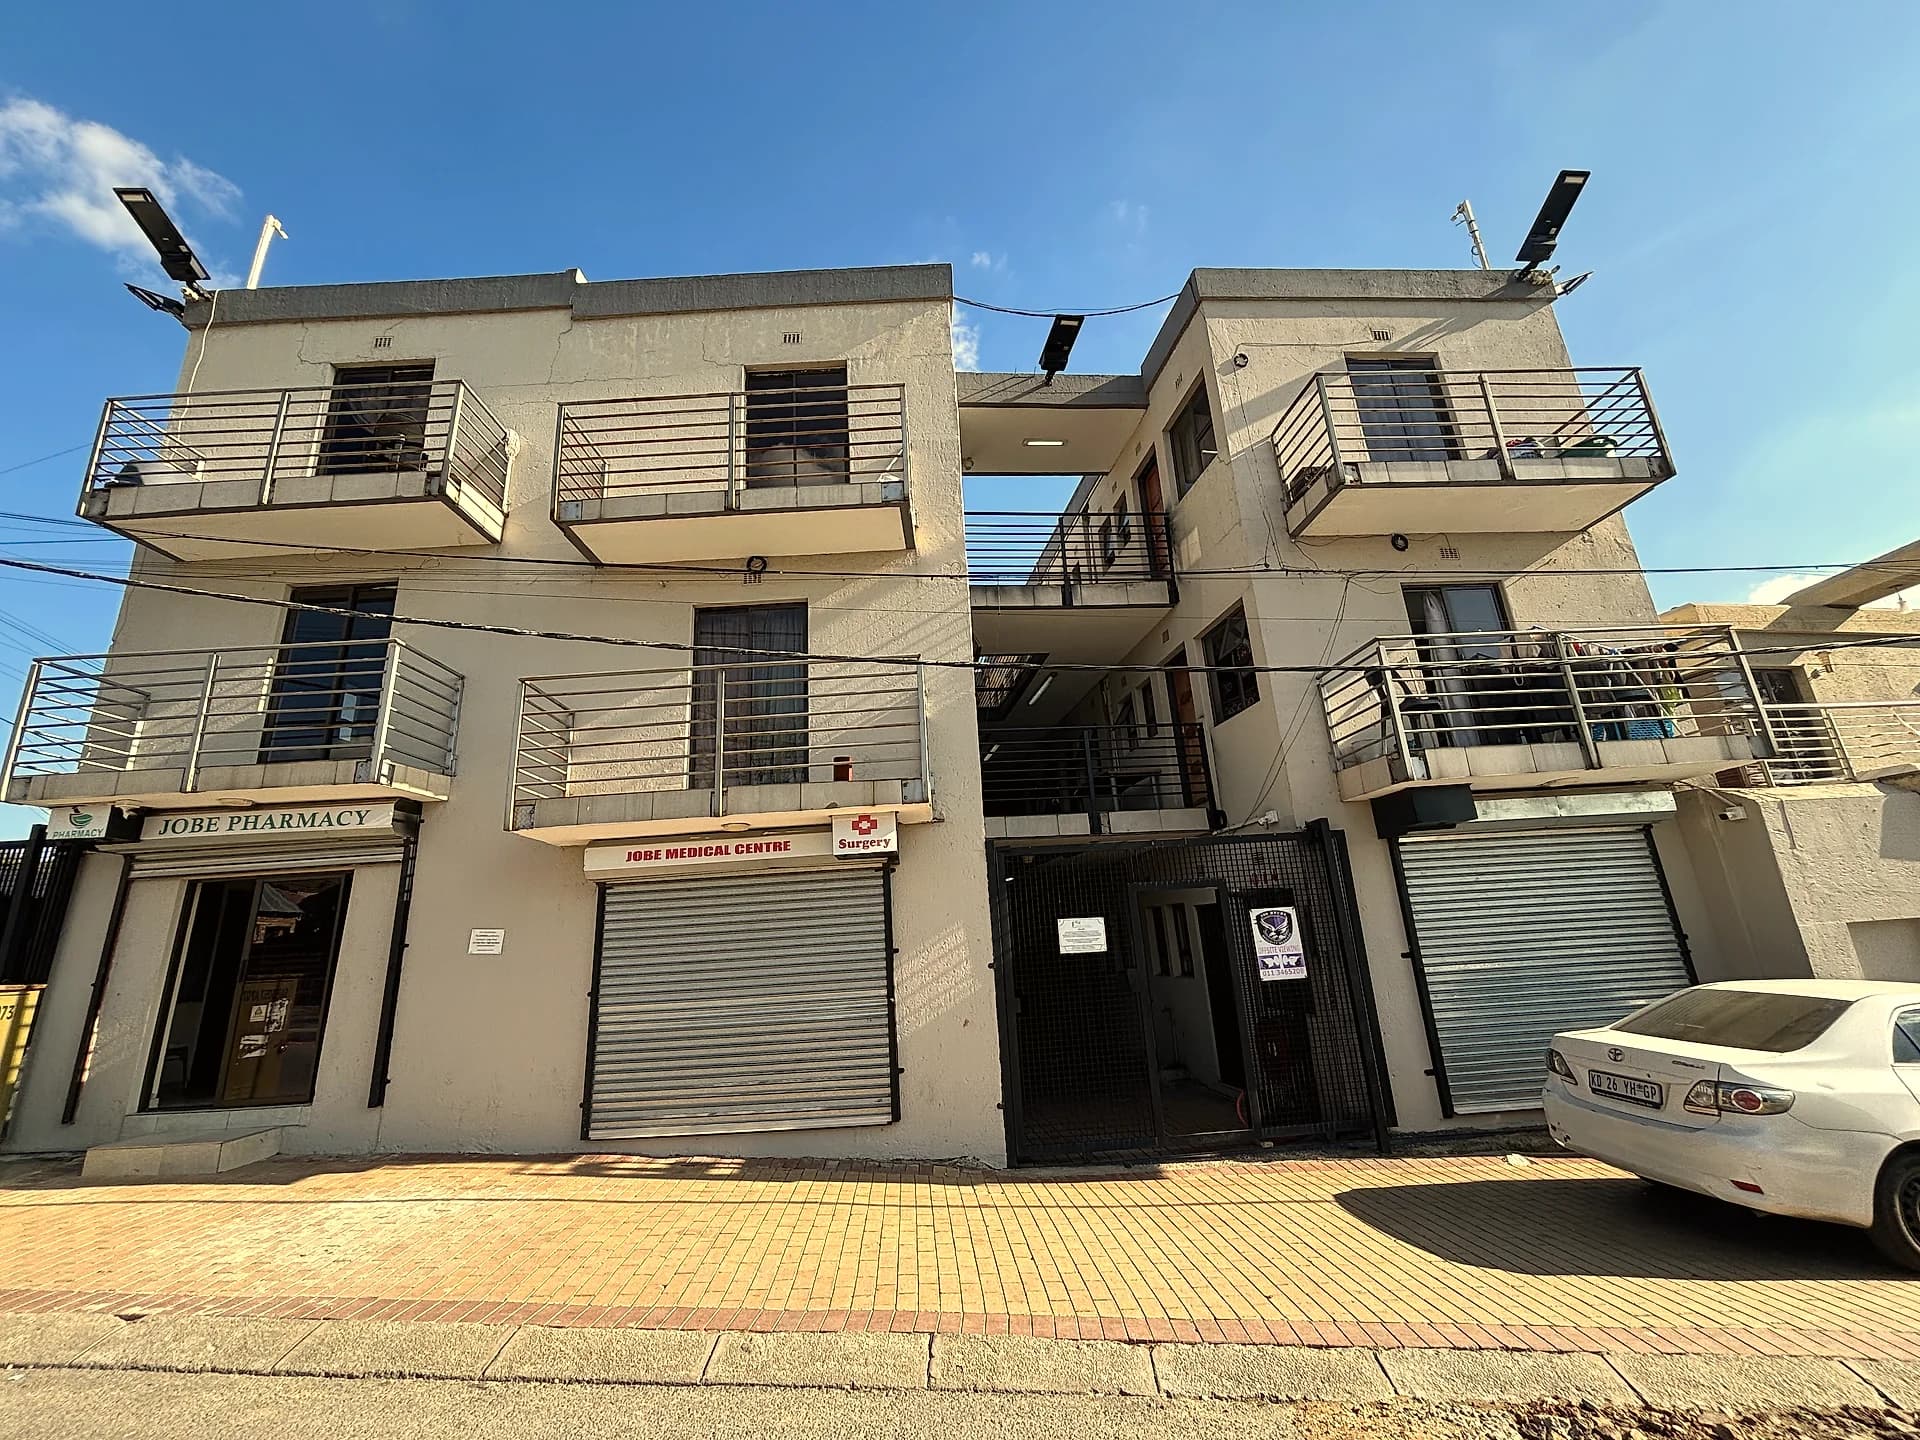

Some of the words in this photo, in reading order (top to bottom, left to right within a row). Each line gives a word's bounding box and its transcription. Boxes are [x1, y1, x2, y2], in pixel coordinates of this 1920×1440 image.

[158, 816, 221, 836] JOBE
[227, 809, 372, 832] PHARMACY
[52, 828, 104, 839] PHARMACY
[626, 849, 662, 863] JOBE
[665, 844, 731, 860] MEDICAL
[734, 840, 791, 856] CENTRE
[838, 837, 891, 850] Surgery
[0, 1005, 15, 1020] 73
[1590, 1073, 1602, 1088] KD
[1607, 1077, 1618, 1092] 26
[1623, 1082, 1637, 1096] YH
[1643, 1085, 1657, 1100] GP
